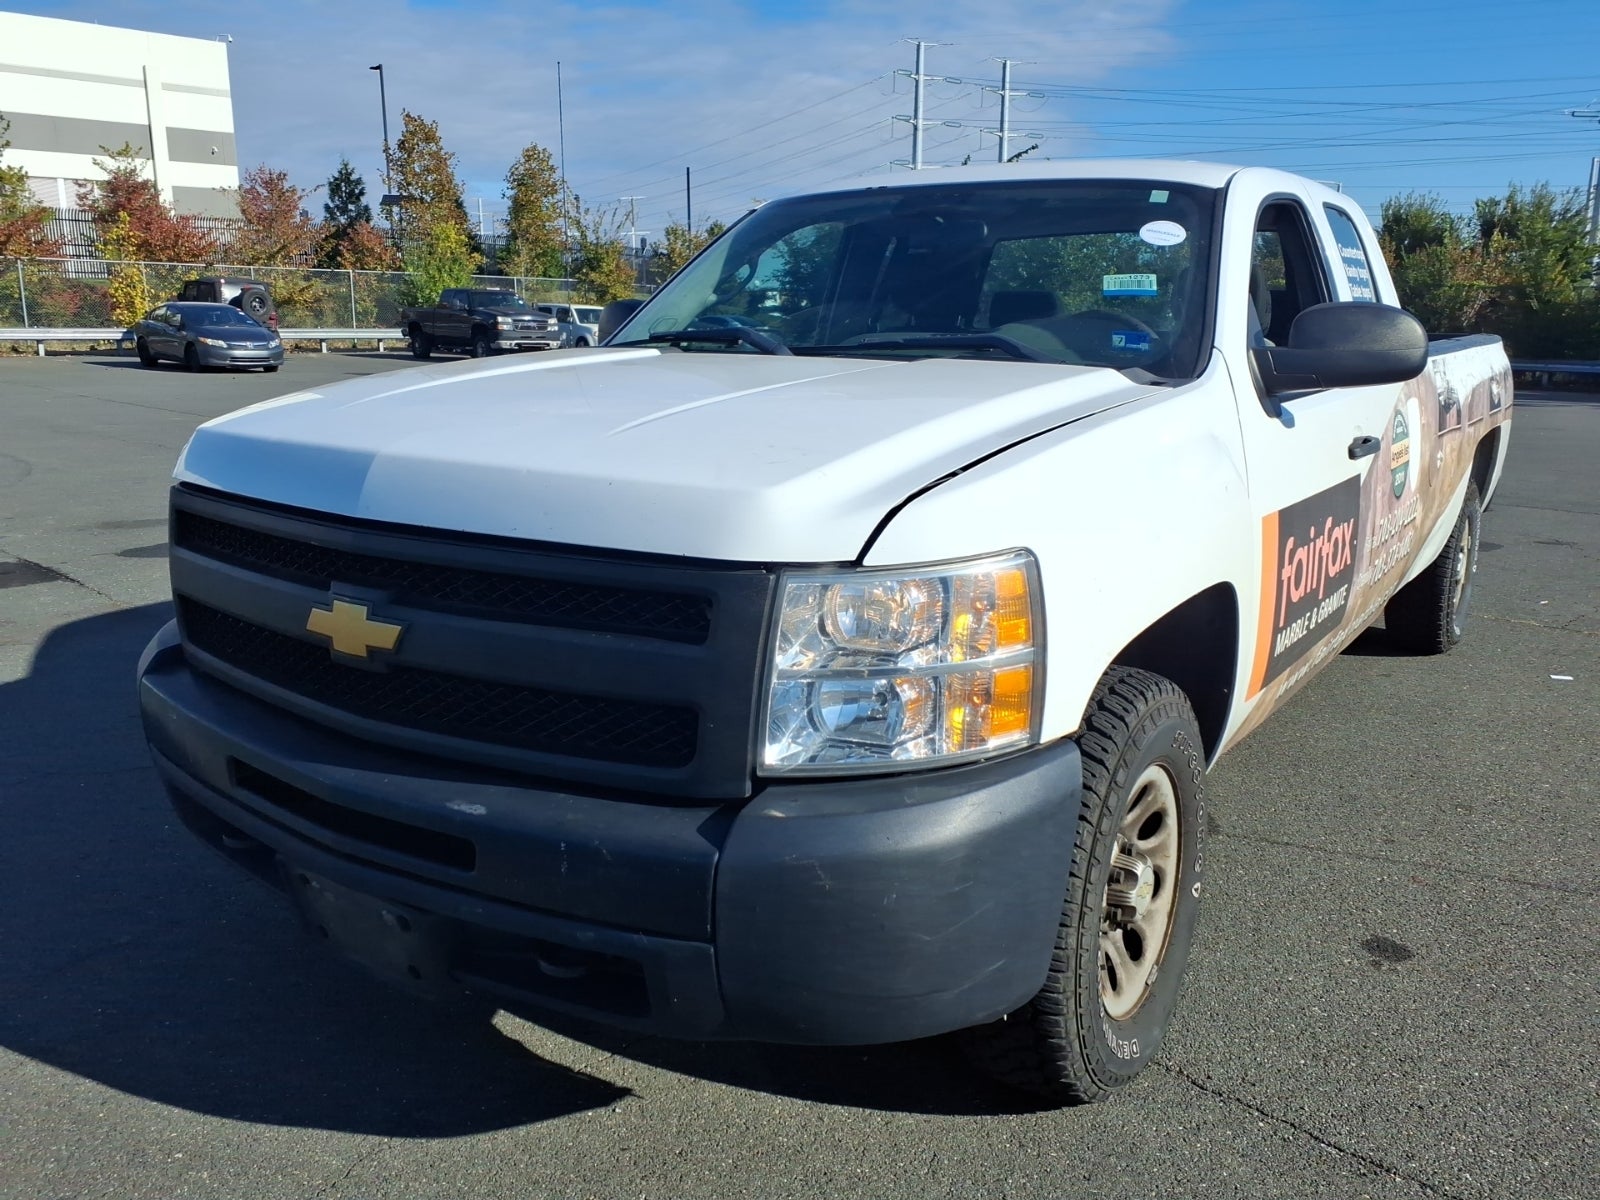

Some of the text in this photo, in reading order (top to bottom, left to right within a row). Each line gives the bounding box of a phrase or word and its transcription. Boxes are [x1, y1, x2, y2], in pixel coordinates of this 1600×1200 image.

[1280, 517, 1354, 627] fairfax
[1274, 584, 1349, 657] MARBLE & GRANITE
